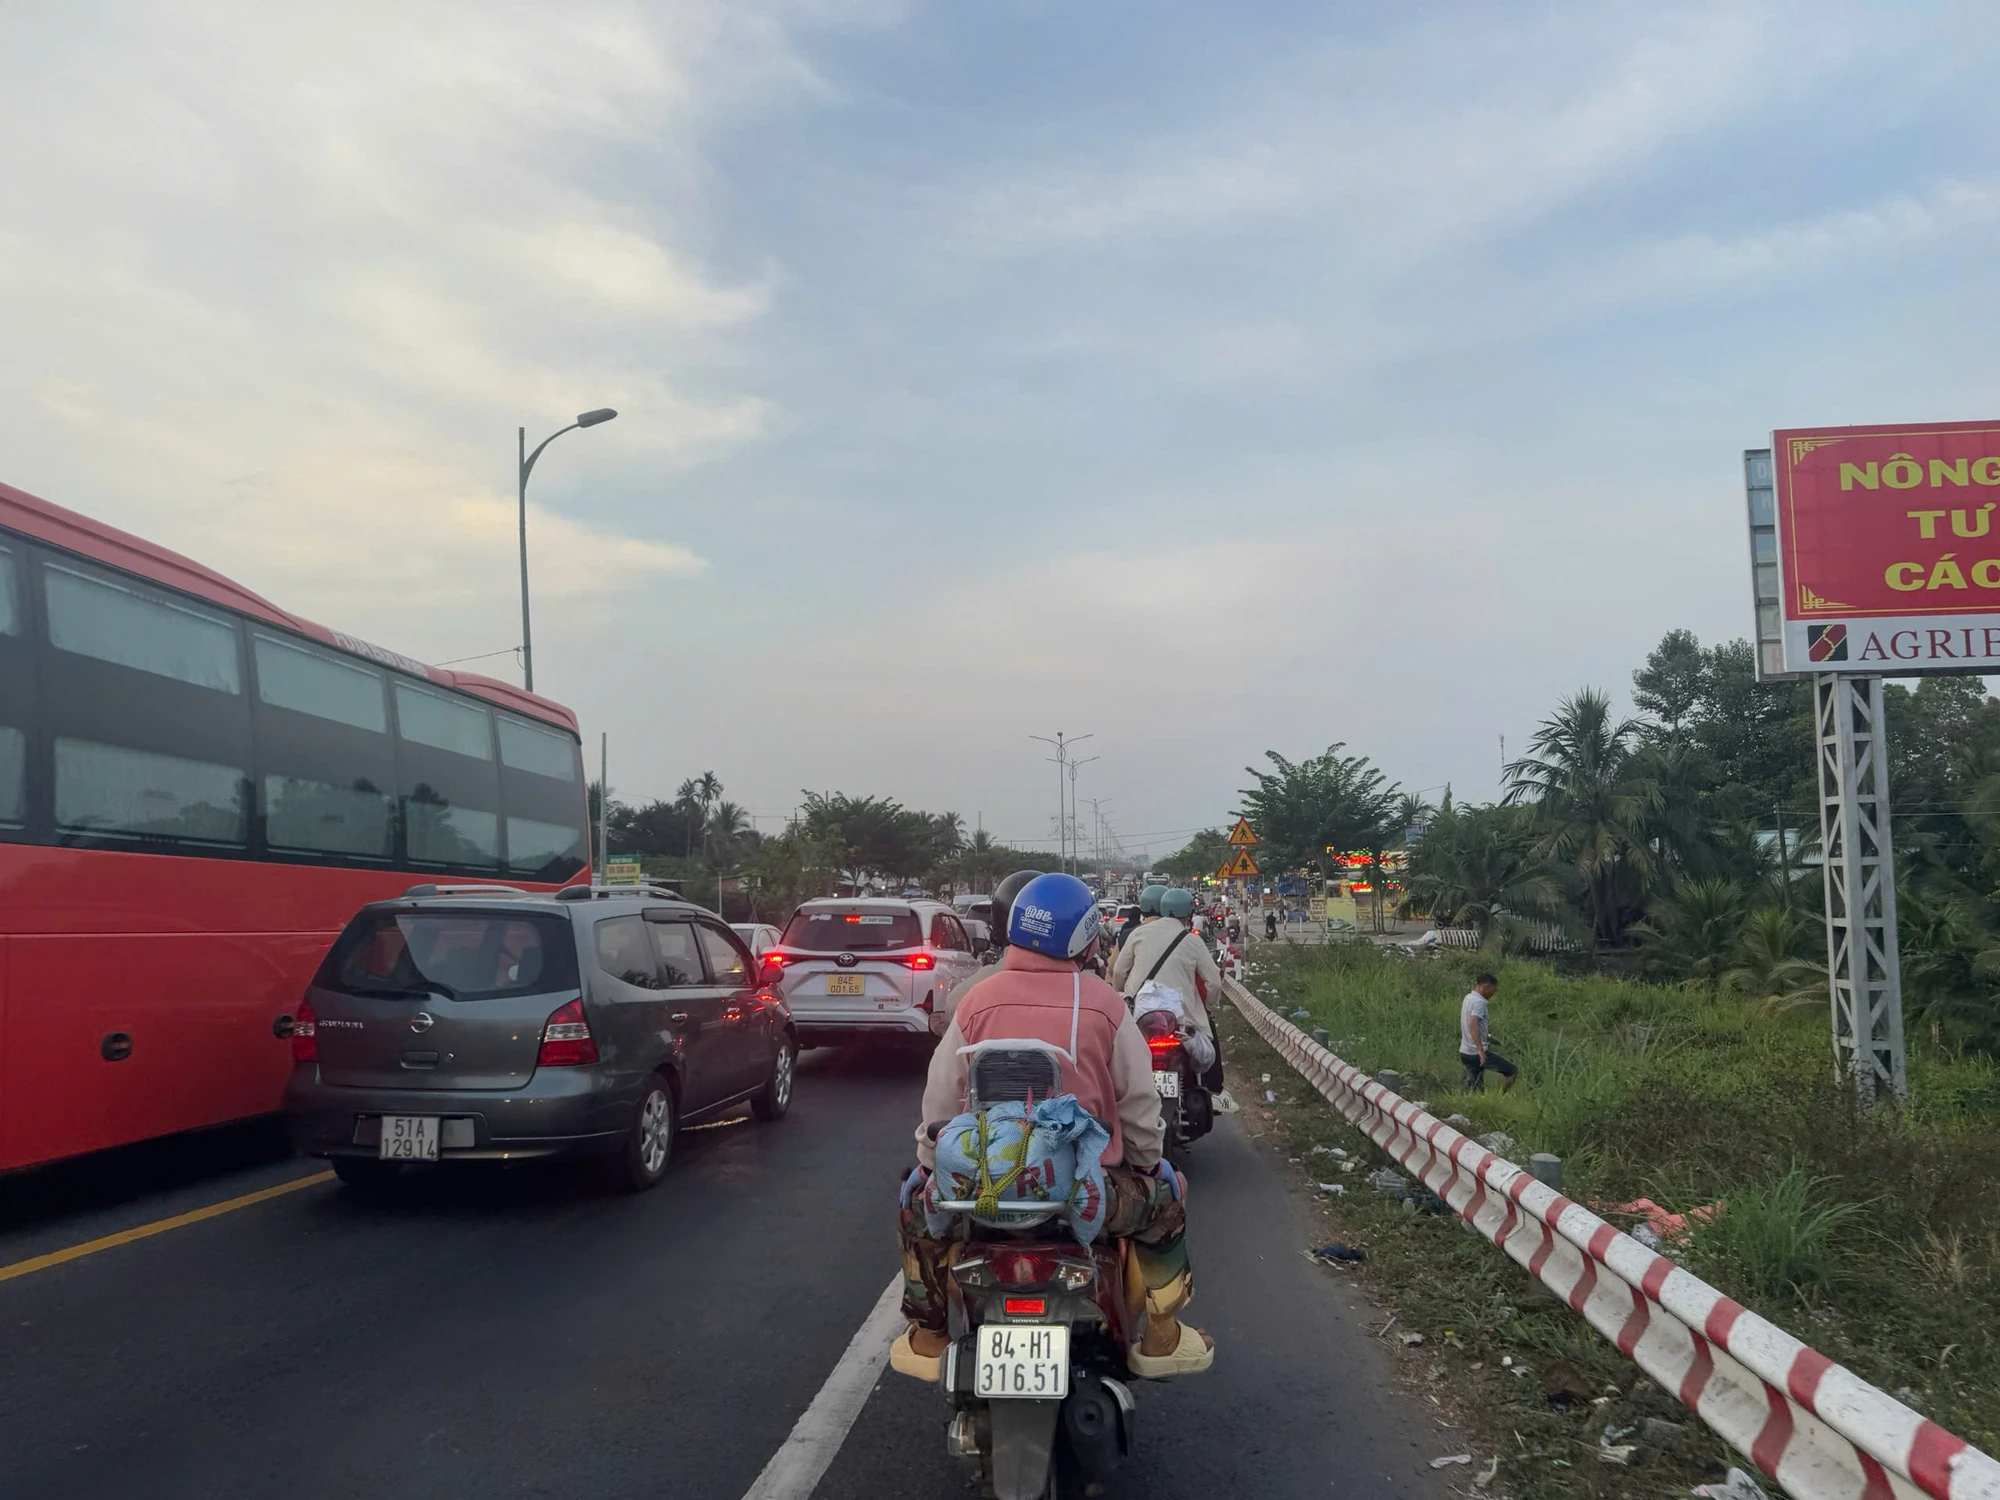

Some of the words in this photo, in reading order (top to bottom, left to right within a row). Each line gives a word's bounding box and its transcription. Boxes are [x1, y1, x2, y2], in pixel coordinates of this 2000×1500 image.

[1840, 453, 2000, 490] NÔNG
[1907, 503, 1997, 539] TƯ
[1884, 553, 2000, 591] CÁC
[837, 976, 854, 985] 84E
[394, 1118, 425, 1138] 51A
[991, 1330, 1052, 1359] 84-H1
[981, 1362, 1059, 1392] 316.51
